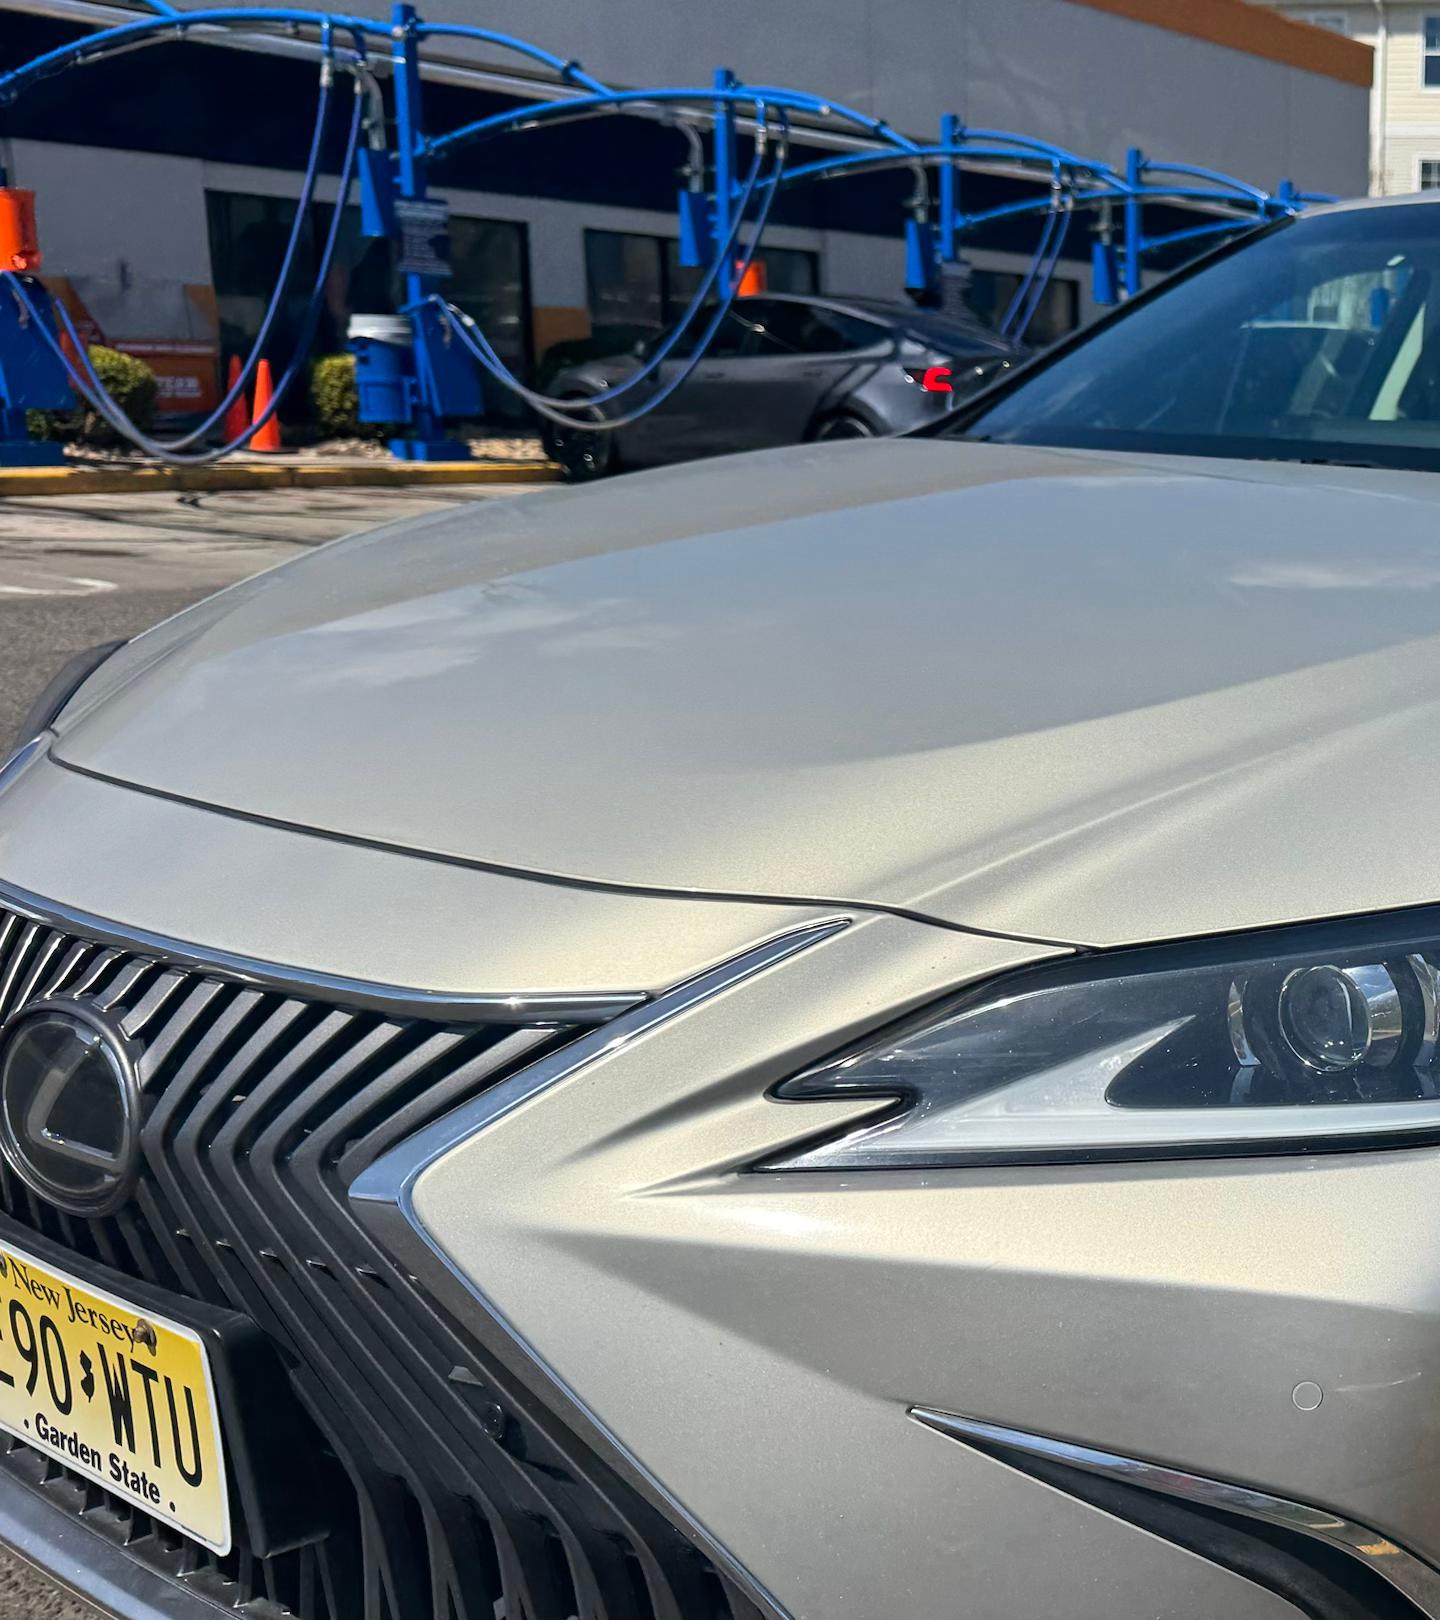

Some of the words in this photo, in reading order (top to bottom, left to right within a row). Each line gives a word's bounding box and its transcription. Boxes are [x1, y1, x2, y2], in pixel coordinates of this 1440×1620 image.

[8, 1257, 61, 1310] New
[61, 1286, 139, 1353] Jersey
[35, 1412, 102, 1472] Garden
[109, 1452, 161, 1504] State
